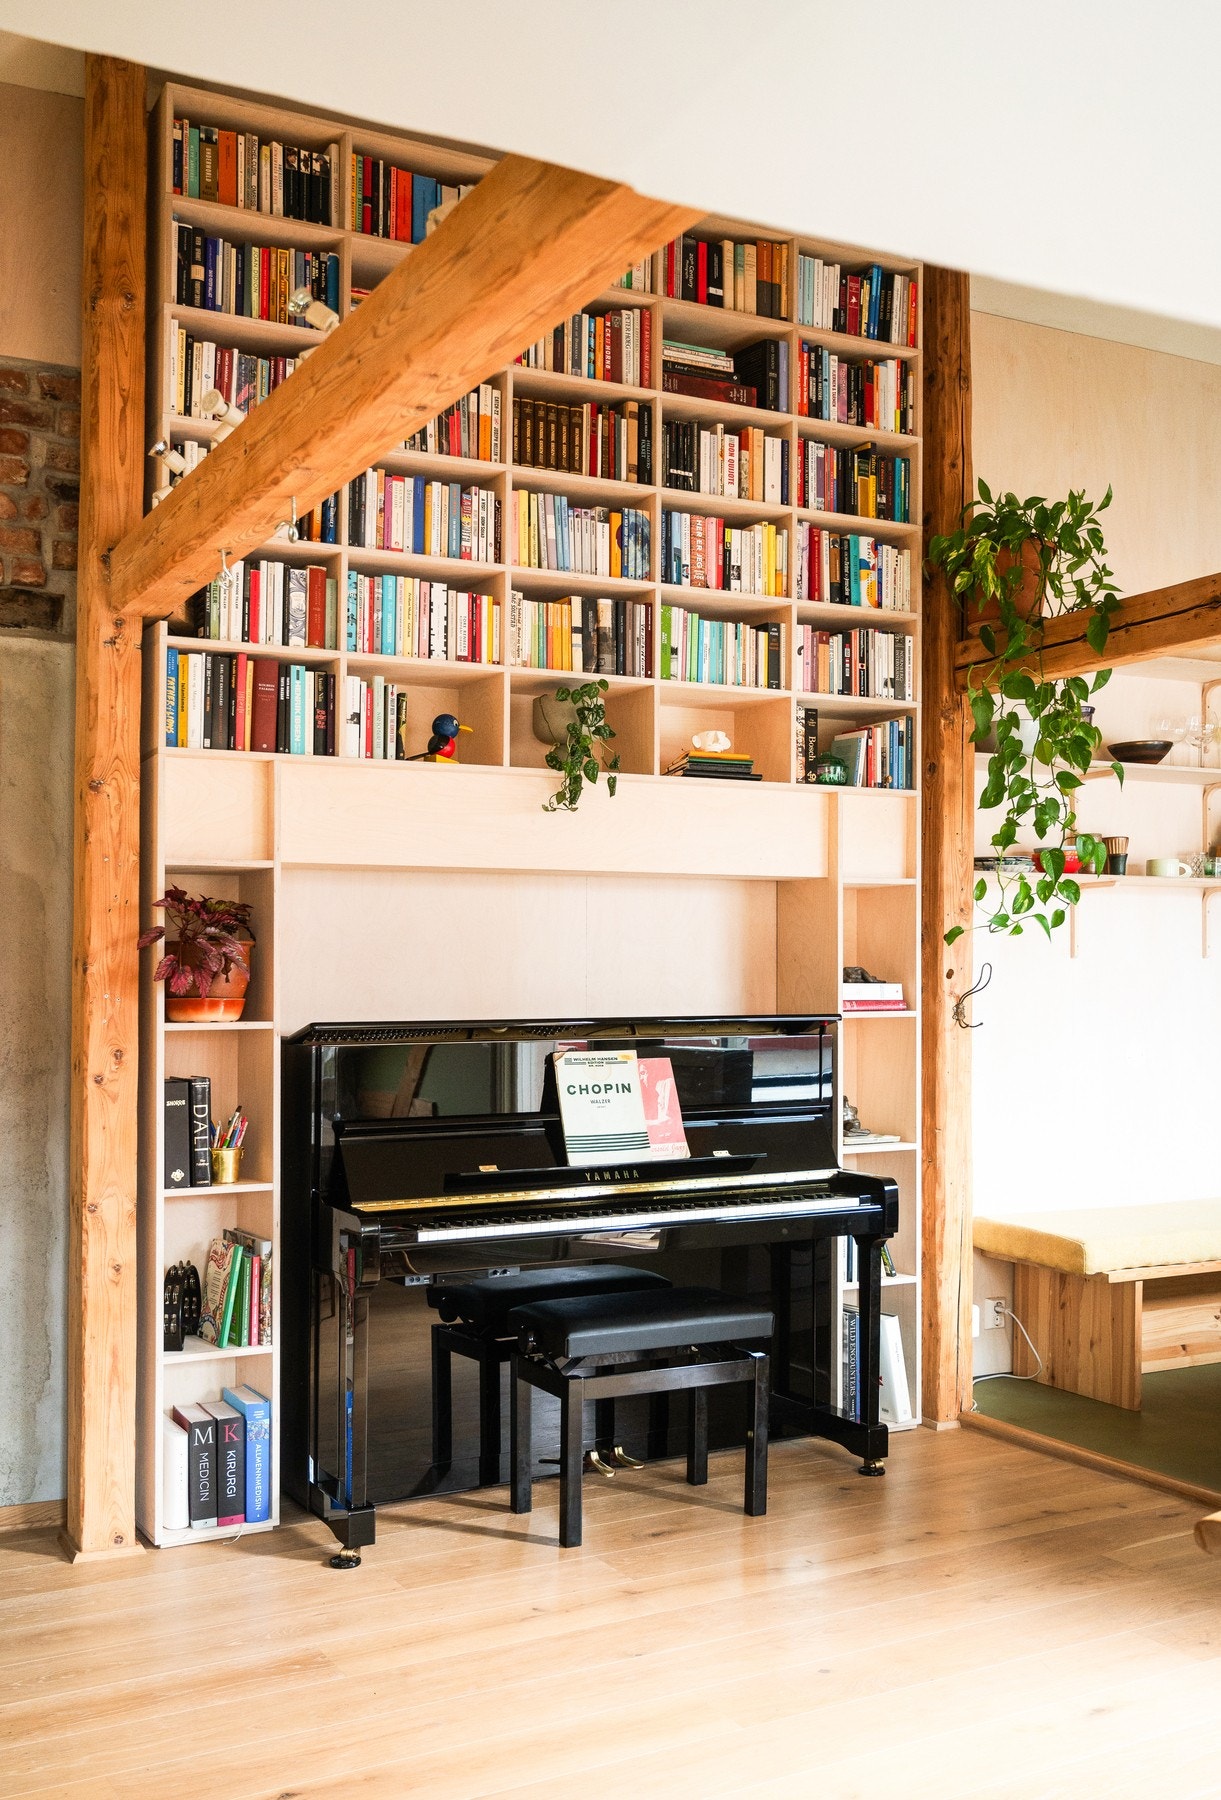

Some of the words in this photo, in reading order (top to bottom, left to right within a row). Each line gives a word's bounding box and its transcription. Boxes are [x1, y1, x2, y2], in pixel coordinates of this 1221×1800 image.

[696, 540, 702, 551] ER
[167, 677, 176, 706] FATHER
[166, 711, 175, 733] LIONS
[808, 736, 816, 762] Bosch
[566, 1083, 632, 1095] CHOPIN
[585, 1170, 639, 1181] YAMAHA
[193, 1426, 214, 1446] M
[224, 1423, 240, 1443] K
[199, 1453, 209, 1502] MEDICIN
[226, 1450, 237, 1498] KIRURGI
